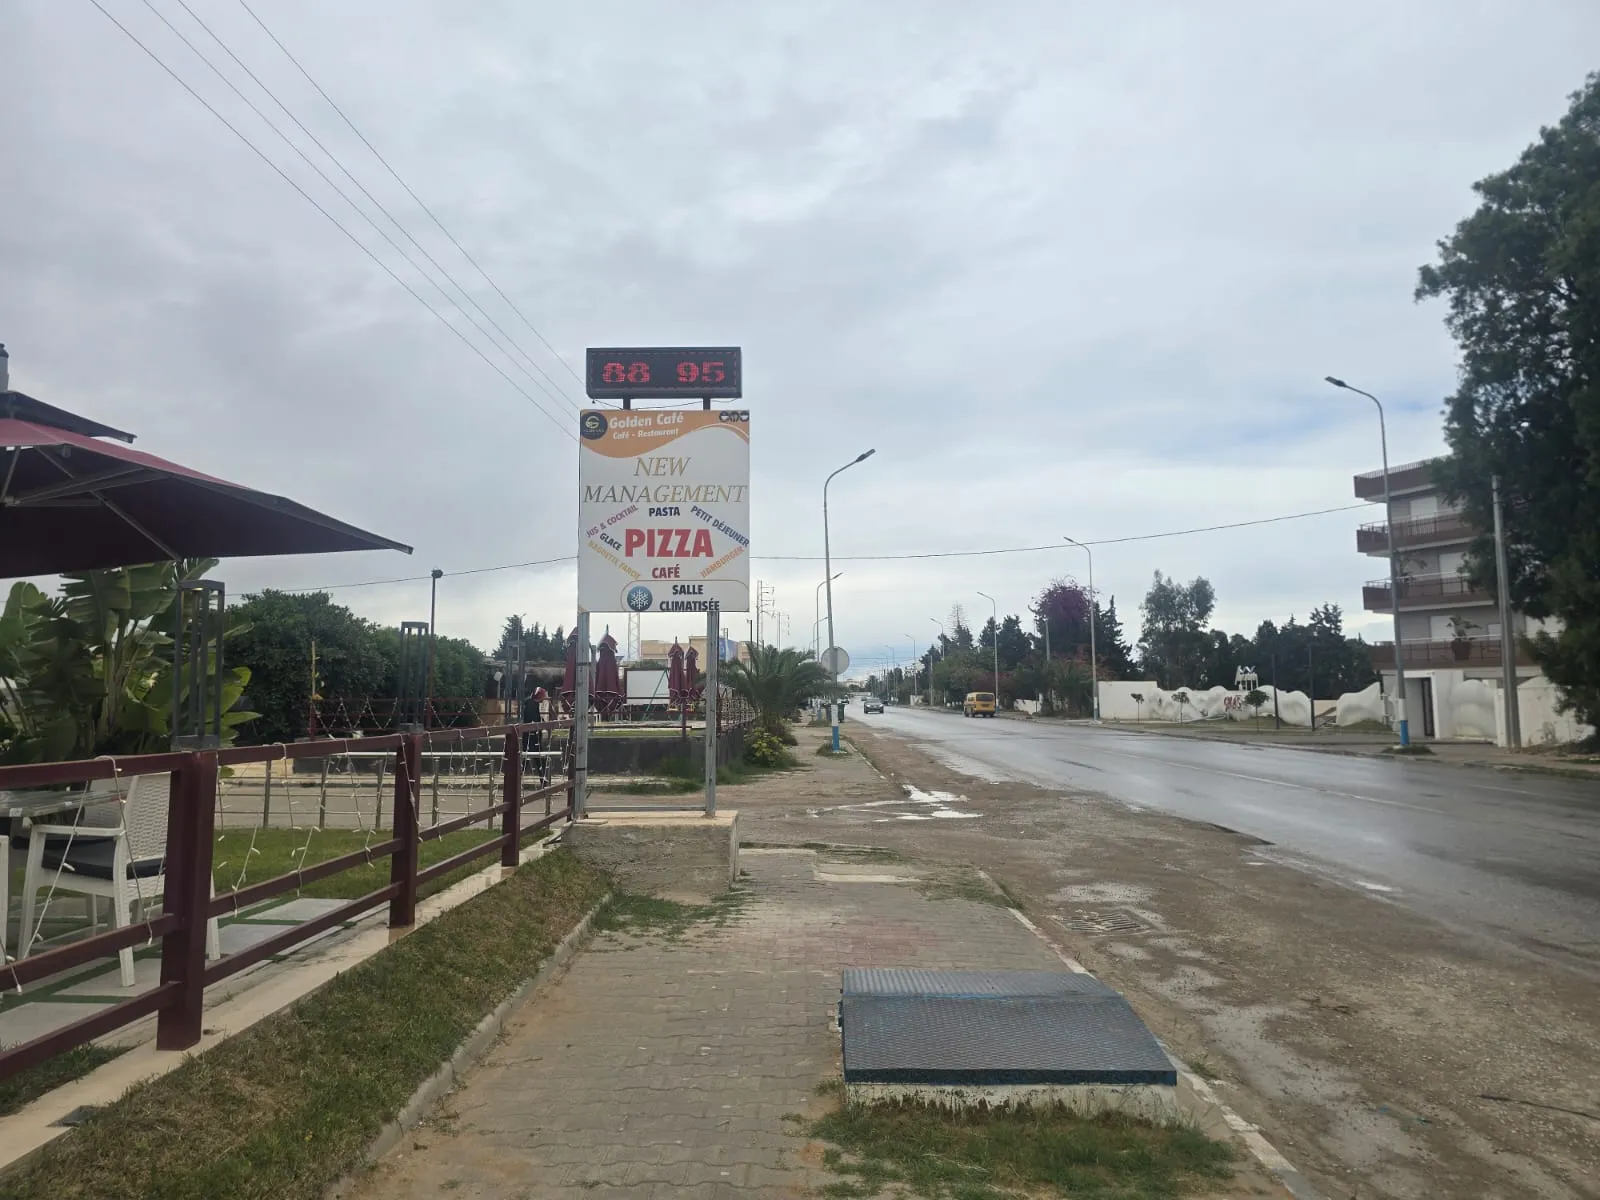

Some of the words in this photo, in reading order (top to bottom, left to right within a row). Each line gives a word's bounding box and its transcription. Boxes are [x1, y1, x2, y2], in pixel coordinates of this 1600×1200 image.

[608, 415, 652, 429] Golden
[657, 412, 684, 425] Café
[613, 430, 630, 440] Café
[638, 428, 679, 438] Restaurant
[633, 457, 692, 476] NEW
[583, 484, 748, 503] MANAGEMENT
[586, 526, 599, 538] JUS
[599, 522, 606, 530] &
[606, 504, 639, 526] COCKTAIL
[648, 506, 681, 517] PASTA
[690, 505, 713, 523] PETIT
[712, 518, 750, 548] DÉJEUNER
[599, 532, 623, 551] GLACE
[625, 528, 714, 557] PIZZA
[651, 564, 681, 579] CAFÉ
[700, 545, 745, 579] HAMBURGER
[672, 584, 704, 595] SALLE
[659, 597, 720, 611] CLIMATISÉE
